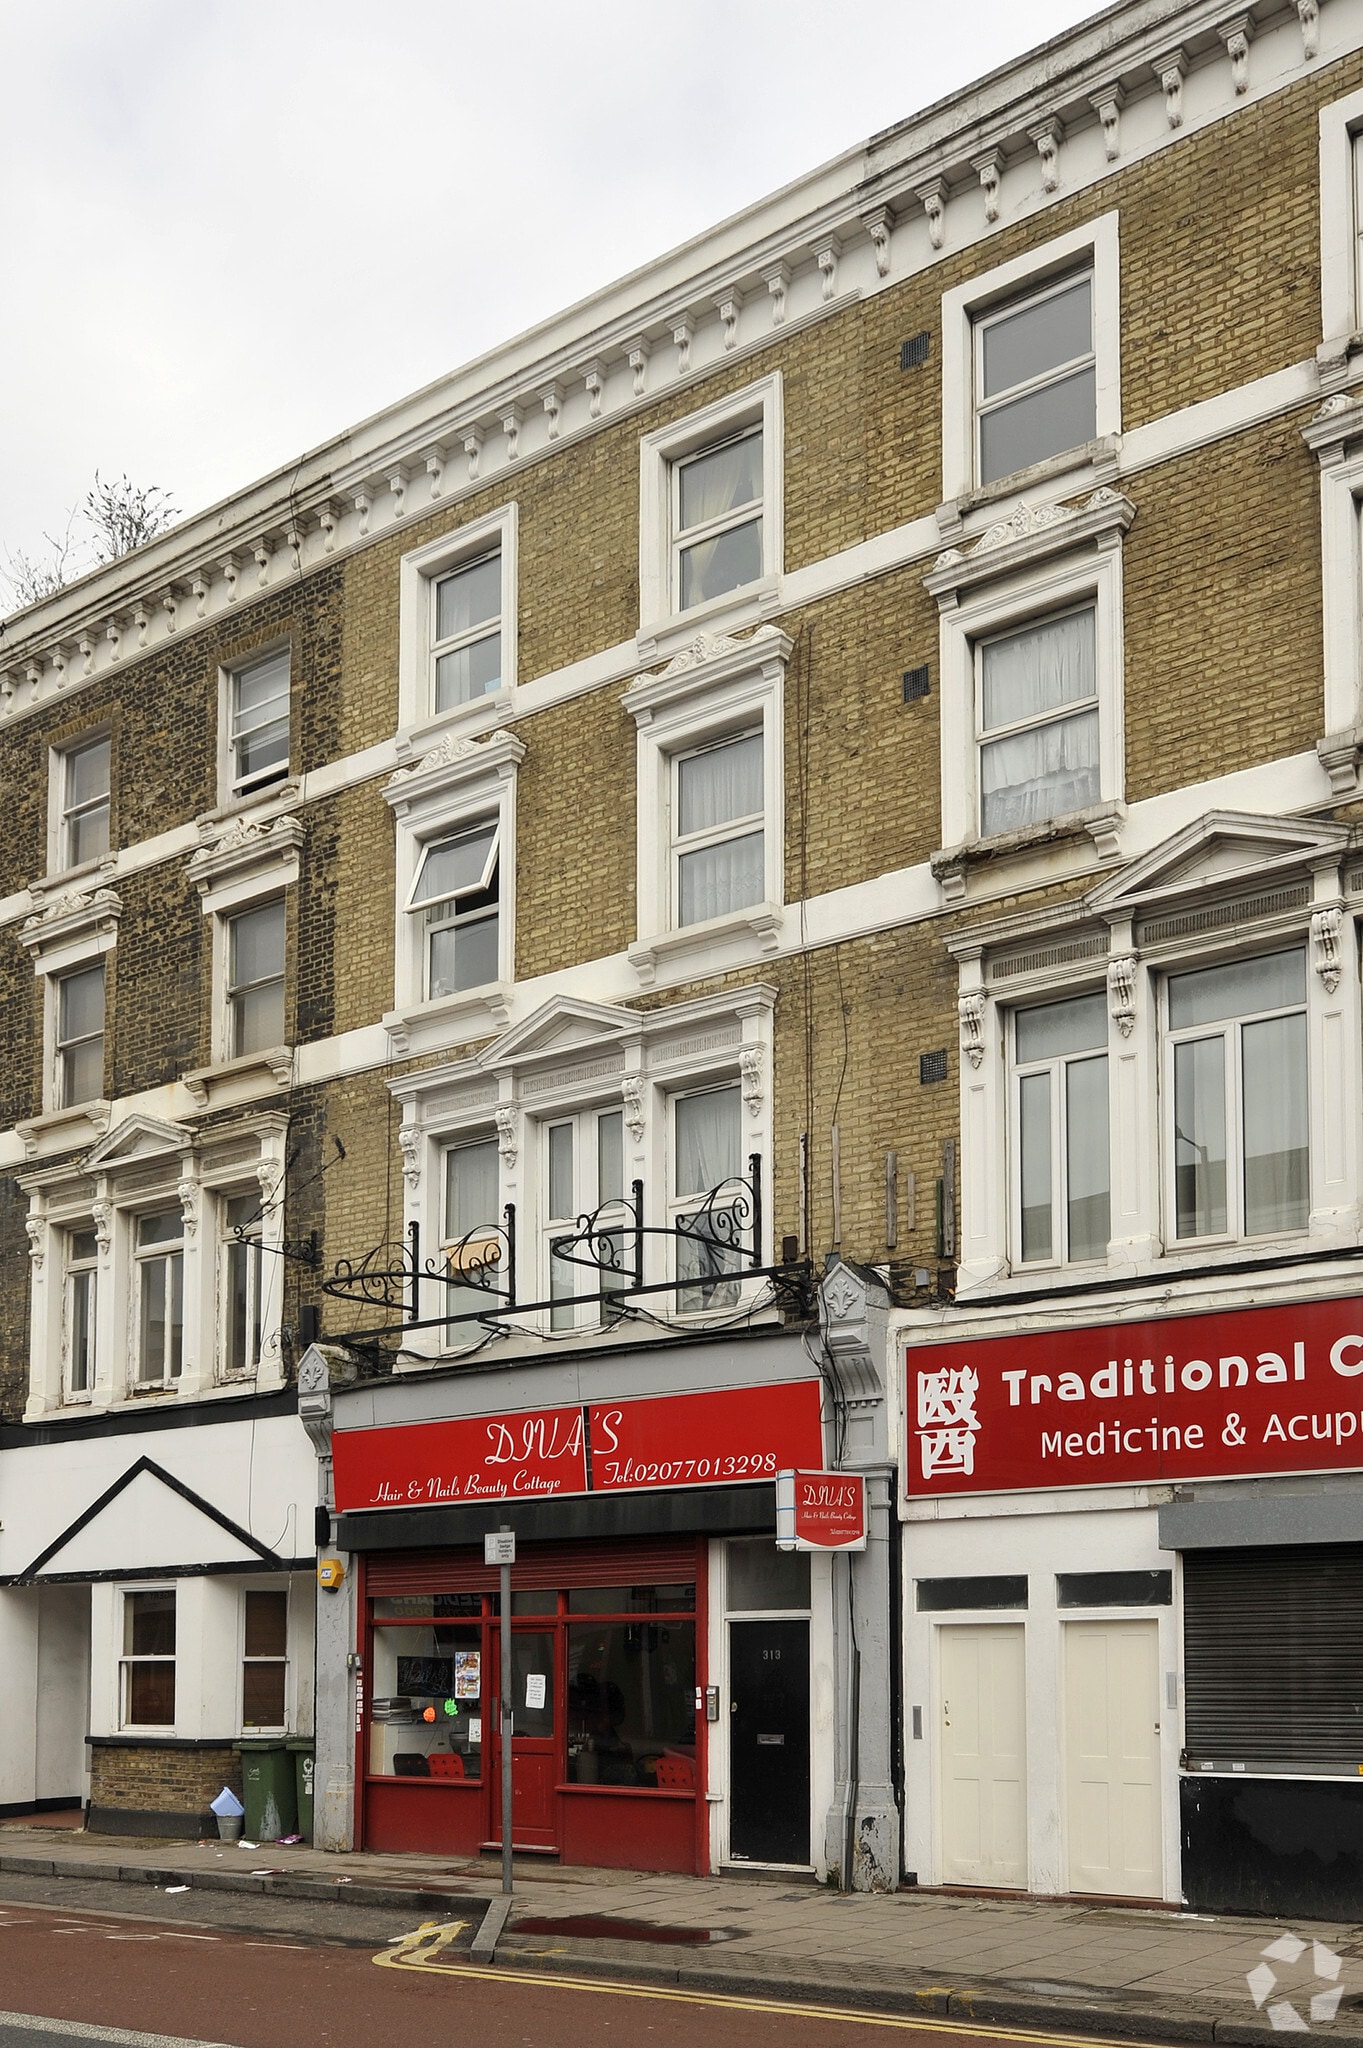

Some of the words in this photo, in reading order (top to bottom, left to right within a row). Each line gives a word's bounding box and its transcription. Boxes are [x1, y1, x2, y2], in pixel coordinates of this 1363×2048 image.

[1002, 1342, 1306, 1407] Traditional
[484, 1410, 623, 1465] DIVA'S
[913, 1364, 982, 1480] 醫
[1042, 1417, 1204, 1459] Medicine
[1221, 1412, 1247, 1447] &
[1262, 1410, 1363, 1446] Acup
[369, 1481, 403, 1502] Hair
[407, 1480, 424, 1500] &
[427, 1475, 460, 1498] Nails
[464, 1473, 508, 1497] Beauty
[512, 1469, 561, 1494] Cottage
[603, 1452, 777, 1484] Tel:02077013298
[802, 1484, 856, 1507] DIVA'S
[762, 1649, 781, 1660] 313
